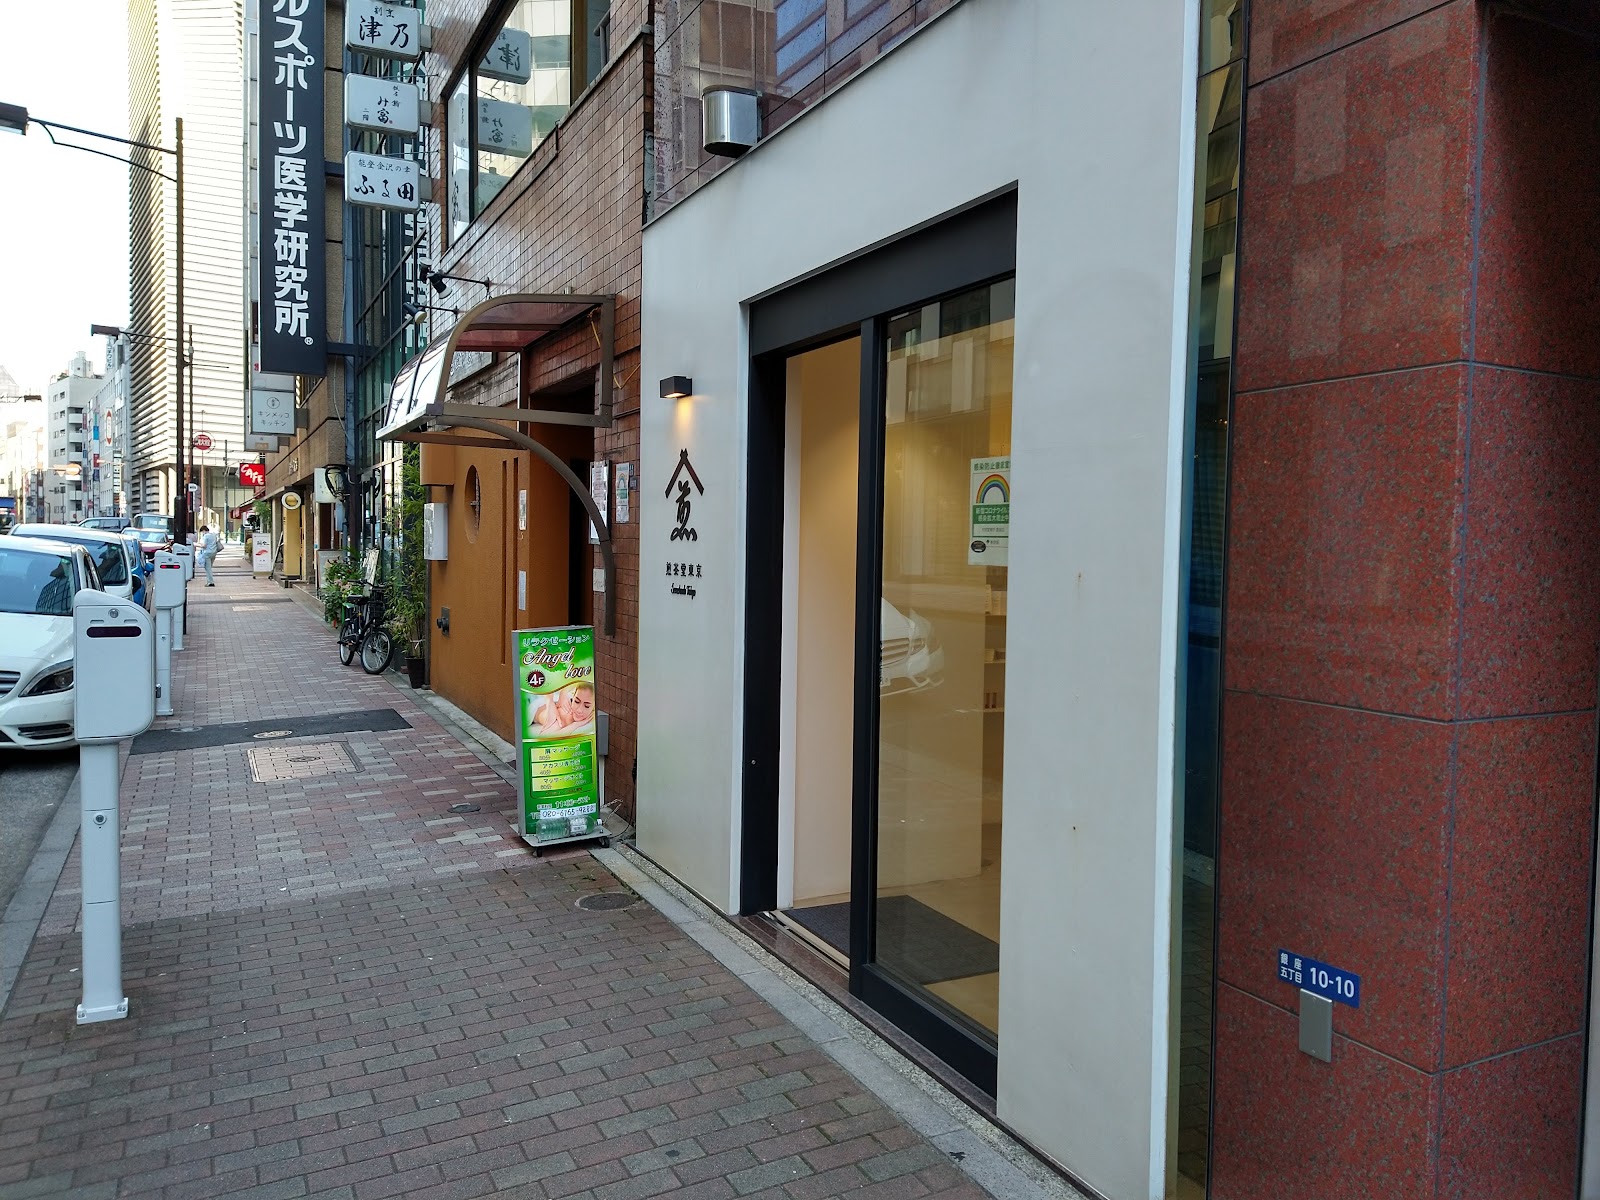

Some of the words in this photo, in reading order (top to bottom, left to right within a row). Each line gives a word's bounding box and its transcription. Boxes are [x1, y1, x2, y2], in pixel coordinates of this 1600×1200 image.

[359, 15, 410, 49] 津乃
[240, 463, 265, 486] CAFE
[522, 646, 575, 667] Angel
[528, 673, 545, 686] 4F
[564, 663, 592, 679] love
[1280, 952, 1303, 971] 銀座
[1280, 966, 1303, 984] 五丁目
[1310, 967, 1355, 998] 10-10
